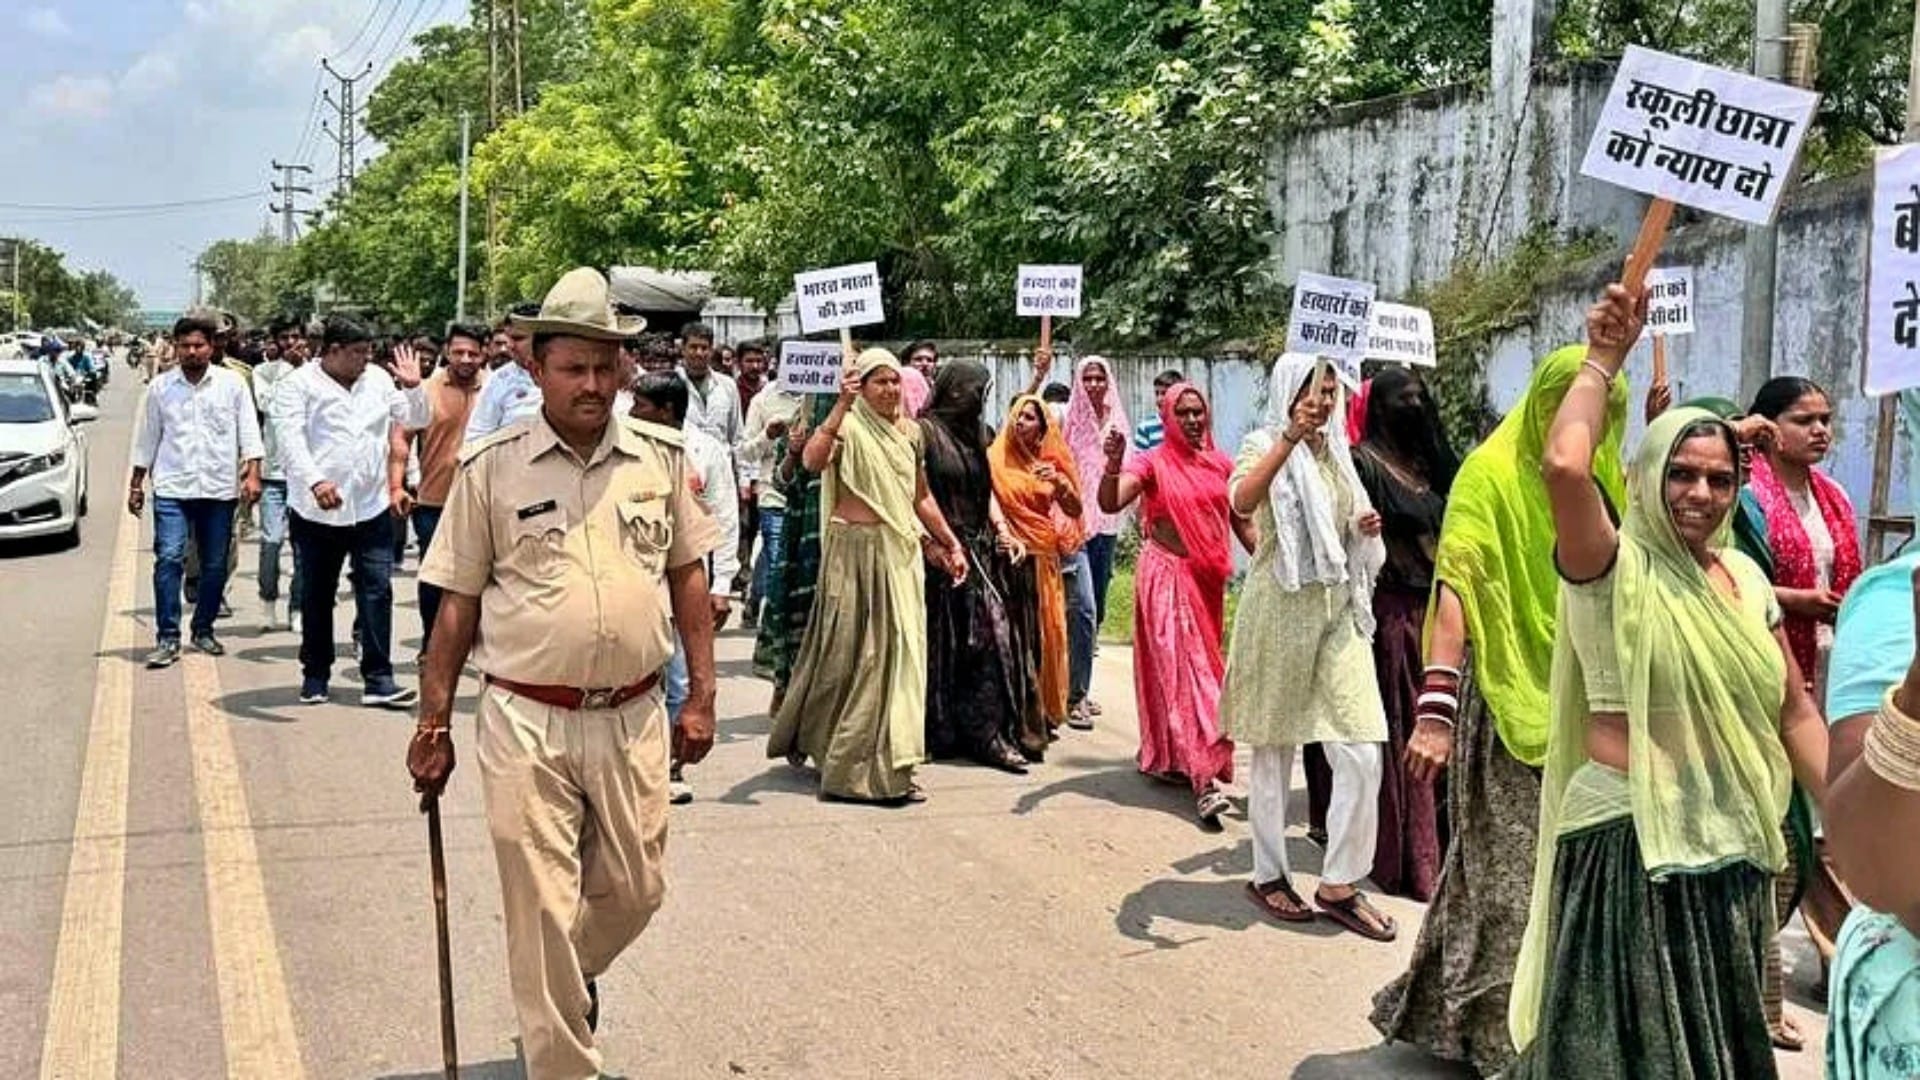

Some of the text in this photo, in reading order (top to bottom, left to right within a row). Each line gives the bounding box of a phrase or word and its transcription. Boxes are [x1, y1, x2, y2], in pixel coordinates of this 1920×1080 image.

[1626, 79, 1796, 149] स्कूली छात्रा
[1605, 129, 1775, 201] को न्याय दो
[803, 274, 873, 297] भारत माता
[1667, 277, 1687, 297] को
[817, 300, 865, 318] की जय
[1349, 296, 1369, 319] को
[1300, 319, 1357, 349] फांसी दो
